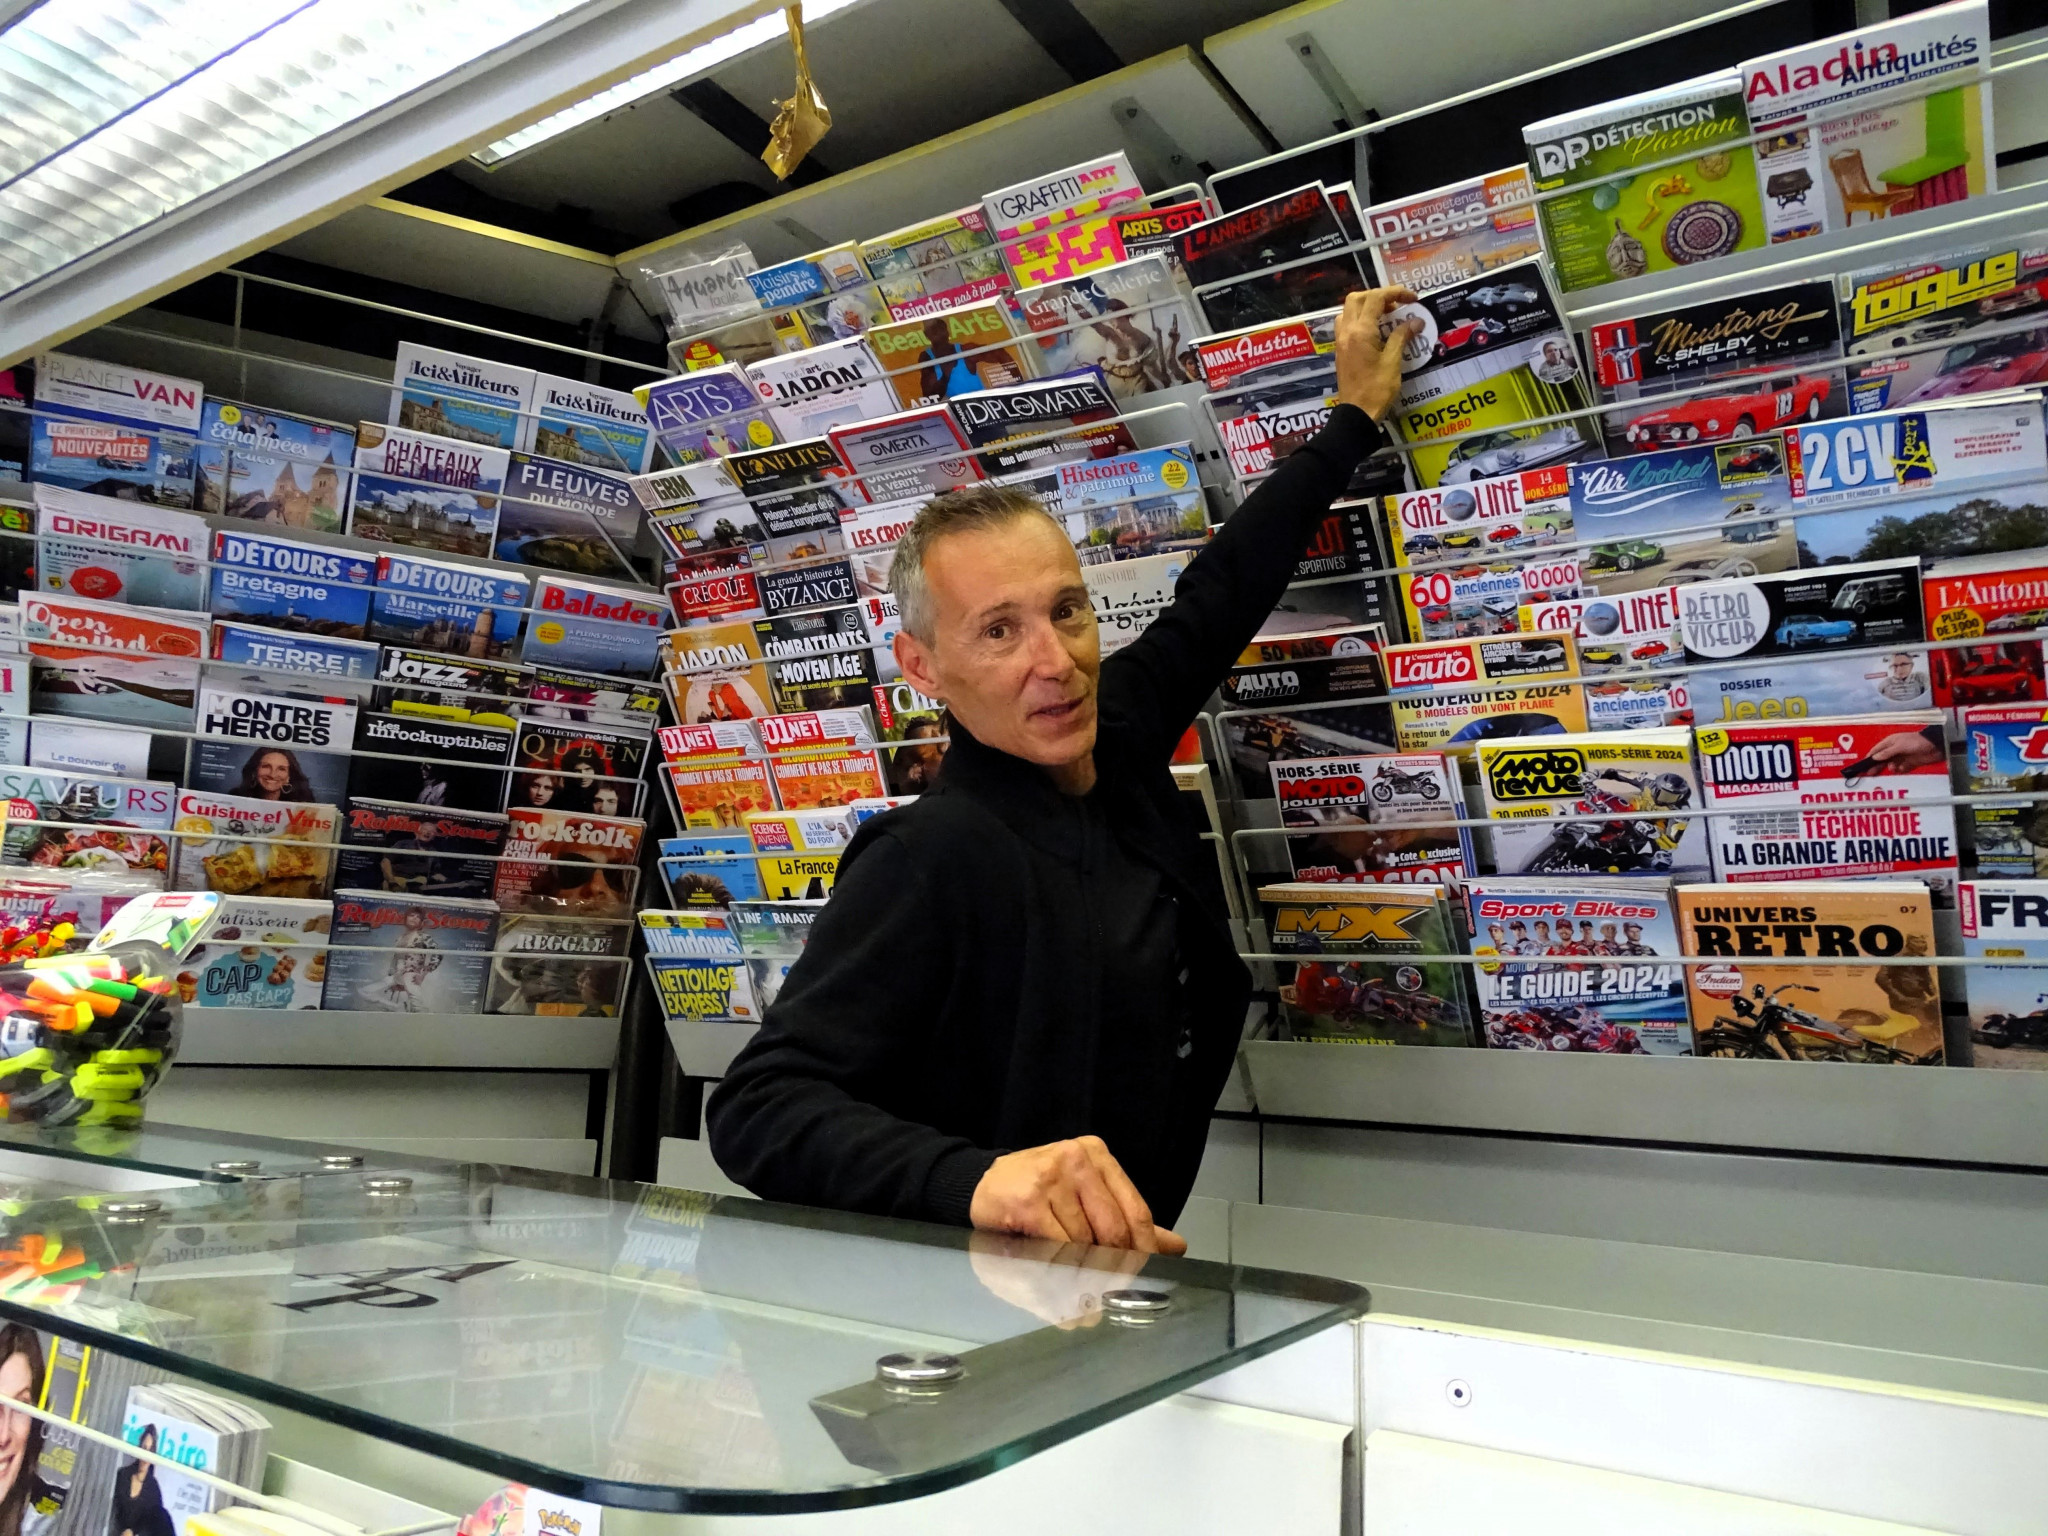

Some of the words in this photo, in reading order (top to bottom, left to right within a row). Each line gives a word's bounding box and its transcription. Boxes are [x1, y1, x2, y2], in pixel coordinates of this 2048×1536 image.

[1747, 39, 1898, 102] Aladin
[1841, 35, 1977, 86] Antiquités
[1592, 104, 1715, 151] DÉTECTION
[1624, 116, 1737, 163] Passion
[1001, 176, 1082, 218] GRAFFITI
[1489, 178, 1526, 195] NUMÉRO
[1411, 190, 1484, 218] compétence
[962, 214, 979, 225] 168
[1122, 218, 1163, 239] ARTS
[1166, 209, 1206, 230] CITY
[750, 269, 800, 293] Plaisirs
[1411, 261, 1456, 280] GUIDE
[667, 258, 757, 311] Aquarell
[763, 277, 818, 305] peindre
[1025, 282, 1093, 316] Grande
[1091, 264, 1162, 297] Galerie
[1851, 251, 2018, 336] torque
[892, 295, 951, 322] Peindre
[875, 327, 933, 352] Beau
[1651, 302, 1829, 355] Mustang
[1203, 348, 1237, 369] MAXI
[1234, 330, 1308, 361] Austin
[1666, 336, 1809, 371] MAGAZINE
[1674, 334, 1756, 362] SHELBY
[51, 359, 125, 392] PLANET
[133, 379, 195, 410] VAN
[1402, 387, 1443, 406] DOSSIER
[652, 383, 734, 430] ARTS
[965, 386, 1105, 425] DIPLOMATIE
[1407, 389, 1497, 434] Porsche
[210, 420, 310, 457] Echappées
[1436, 417, 1472, 438] TURBO
[56, 436, 149, 459] NOUVEAUTÉS
[385, 438, 482, 474] CHÂTEAUX
[1802, 421, 1898, 492] 2CV
[384, 453, 406, 474] DE
[999, 454, 1016, 467] Une
[1061, 458, 1140, 486] Histoire
[1166, 463, 1182, 473] 22
[520, 463, 631, 508] FLEUVES
[1081, 471, 1156, 498] patrimoine
[1538, 473, 1553, 483] 14
[1626, 457, 1713, 492] Cooled
[651, 475, 697, 501] GBM
[872, 483, 886, 496] LA
[1815, 492, 1845, 505] SATELLITE
[1845, 487, 1882, 501] TECHNIQUE
[550, 498, 617, 520] MONDE
[52, 514, 190, 553] ORIGAMI
[850, 528, 877, 548] LES
[876, 520, 915, 545] CROI
[227, 539, 342, 578] DÉTOURS
[1298, 556, 1347, 576] SPORTIVES
[222, 570, 328, 601] Bretagne
[391, 557, 496, 600] DÉTOURS
[767, 577, 776, 588] La
[776, 573, 804, 589] grande
[804, 569, 834, 582] histoire
[834, 566, 844, 576] de
[1454, 574, 1521, 597] anciennes
[765, 578, 854, 610] BYZANCE
[1409, 573, 1451, 608] 60
[28, 602, 114, 634] Open
[387, 594, 478, 621] Marseille
[541, 585, 660, 627] Balades
[1684, 590, 1752, 622] RÉTRO
[1941, 609, 1968, 623] PLUS
[764, 629, 868, 658] COMBATTANTS
[1686, 619, 1758, 650] VISEUR
[1935, 627, 1950, 637] DE
[247, 642, 345, 671] TERRE
[381, 651, 472, 684] jazz
[780, 658, 832, 684] MOYEN
[833, 653, 863, 678] ÂGE
[1411, 651, 1447, 662] L'essentiel
[1394, 655, 1471, 684] L'auto
[419, 678, 468, 690] magazine
[1236, 671, 1300, 694] AUTO
[1239, 683, 1300, 700] hebdo
[1719, 678, 1773, 692] DOSSIER
[207, 693, 333, 727] MONTRE
[1424, 705, 1469, 718] MODÈLES
[1471, 705, 1488, 715] QUI
[1491, 702, 1516, 713] VONT
[1520, 699, 1555, 711] PLAIRE
[1592, 695, 1667, 714] anciennes
[1713, 695, 1809, 724] Jeep
[205, 714, 331, 746] HEROES
[366, 723, 507, 753] Inrockuptibles
[376, 720, 401, 732] Les
[1411, 729, 1437, 739] retour
[1439, 728, 1451, 737] de
[1700, 732, 1719, 744] 132
[522, 733, 641, 764] QUEEN
[1402, 740, 1411, 749] la
[1411, 740, 1428, 748] star
[1588, 749, 1652, 760] HORS-SÉRIE
[1655, 749, 1684, 761] 2024
[775, 764, 808, 779] COMMENT
[817, 761, 831, 776] PAS
[840, 758, 876, 774] TROMPER
[1276, 762, 1363, 779] HORS-SÉRIE
[1493, 755, 1579, 777] Moto
[1716, 743, 1792, 782] MOTO
[1800, 750, 1813, 769] 5
[674, 771, 703, 787] COMMENT
[735, 766, 765, 781] TROMPER
[1278, 775, 1366, 800] MOTO
[1495, 775, 1583, 797] revue
[1718, 782, 1795, 795] MAGAZINE
[3, 775, 169, 814] SAVEURS
[1280, 790, 1367, 810] journal
[8, 806, 33, 819] 100
[180, 795, 263, 824] Cuisine
[1512, 806, 1550, 819] motos
[436, 819, 500, 841] Stone
[752, 823, 786, 835] SCIENCES
[757, 833, 790, 844] AVENIR
[808, 821, 824, 831] L'IA
[1802, 812, 1922, 840] TECHNIQUE
[505, 839, 540, 851] KURT
[817, 835, 834, 844] FOOT
[1722, 842, 1748, 867] LA
[1752, 840, 1838, 866] GRANDE
[1845, 836, 1950, 864] ARNAQUE
[778, 859, 793, 876] La
[793, 858, 835, 876] France
[1400, 853, 1418, 862] Cote
[1297, 865, 1341, 879] SPÉCIAL
[219, 914, 299, 930] âtisserie
[1276, 905, 1431, 942] MX
[1479, 900, 1566, 922] Sport
[1571, 900, 1659, 921] Bikes
[1693, 906, 1817, 924] UNIVERS
[1899, 906, 1918, 914] 07
[517, 933, 609, 955] REGGAE
[649, 928, 742, 955] Windows
[1694, 923, 1905, 957] RETRO
[206, 964, 261, 996] CAP
[658, 967, 739, 992] NETTOYAGE
[1487, 974, 1515, 1001] LE
[1519, 968, 1596, 1000] GUIDE
[1600, 964, 1673, 995] 2024
[1697, 973, 1743, 985] Indian
[227, 991, 251, 1003] PAS
[664, 992, 721, 1016] EXPRESS
